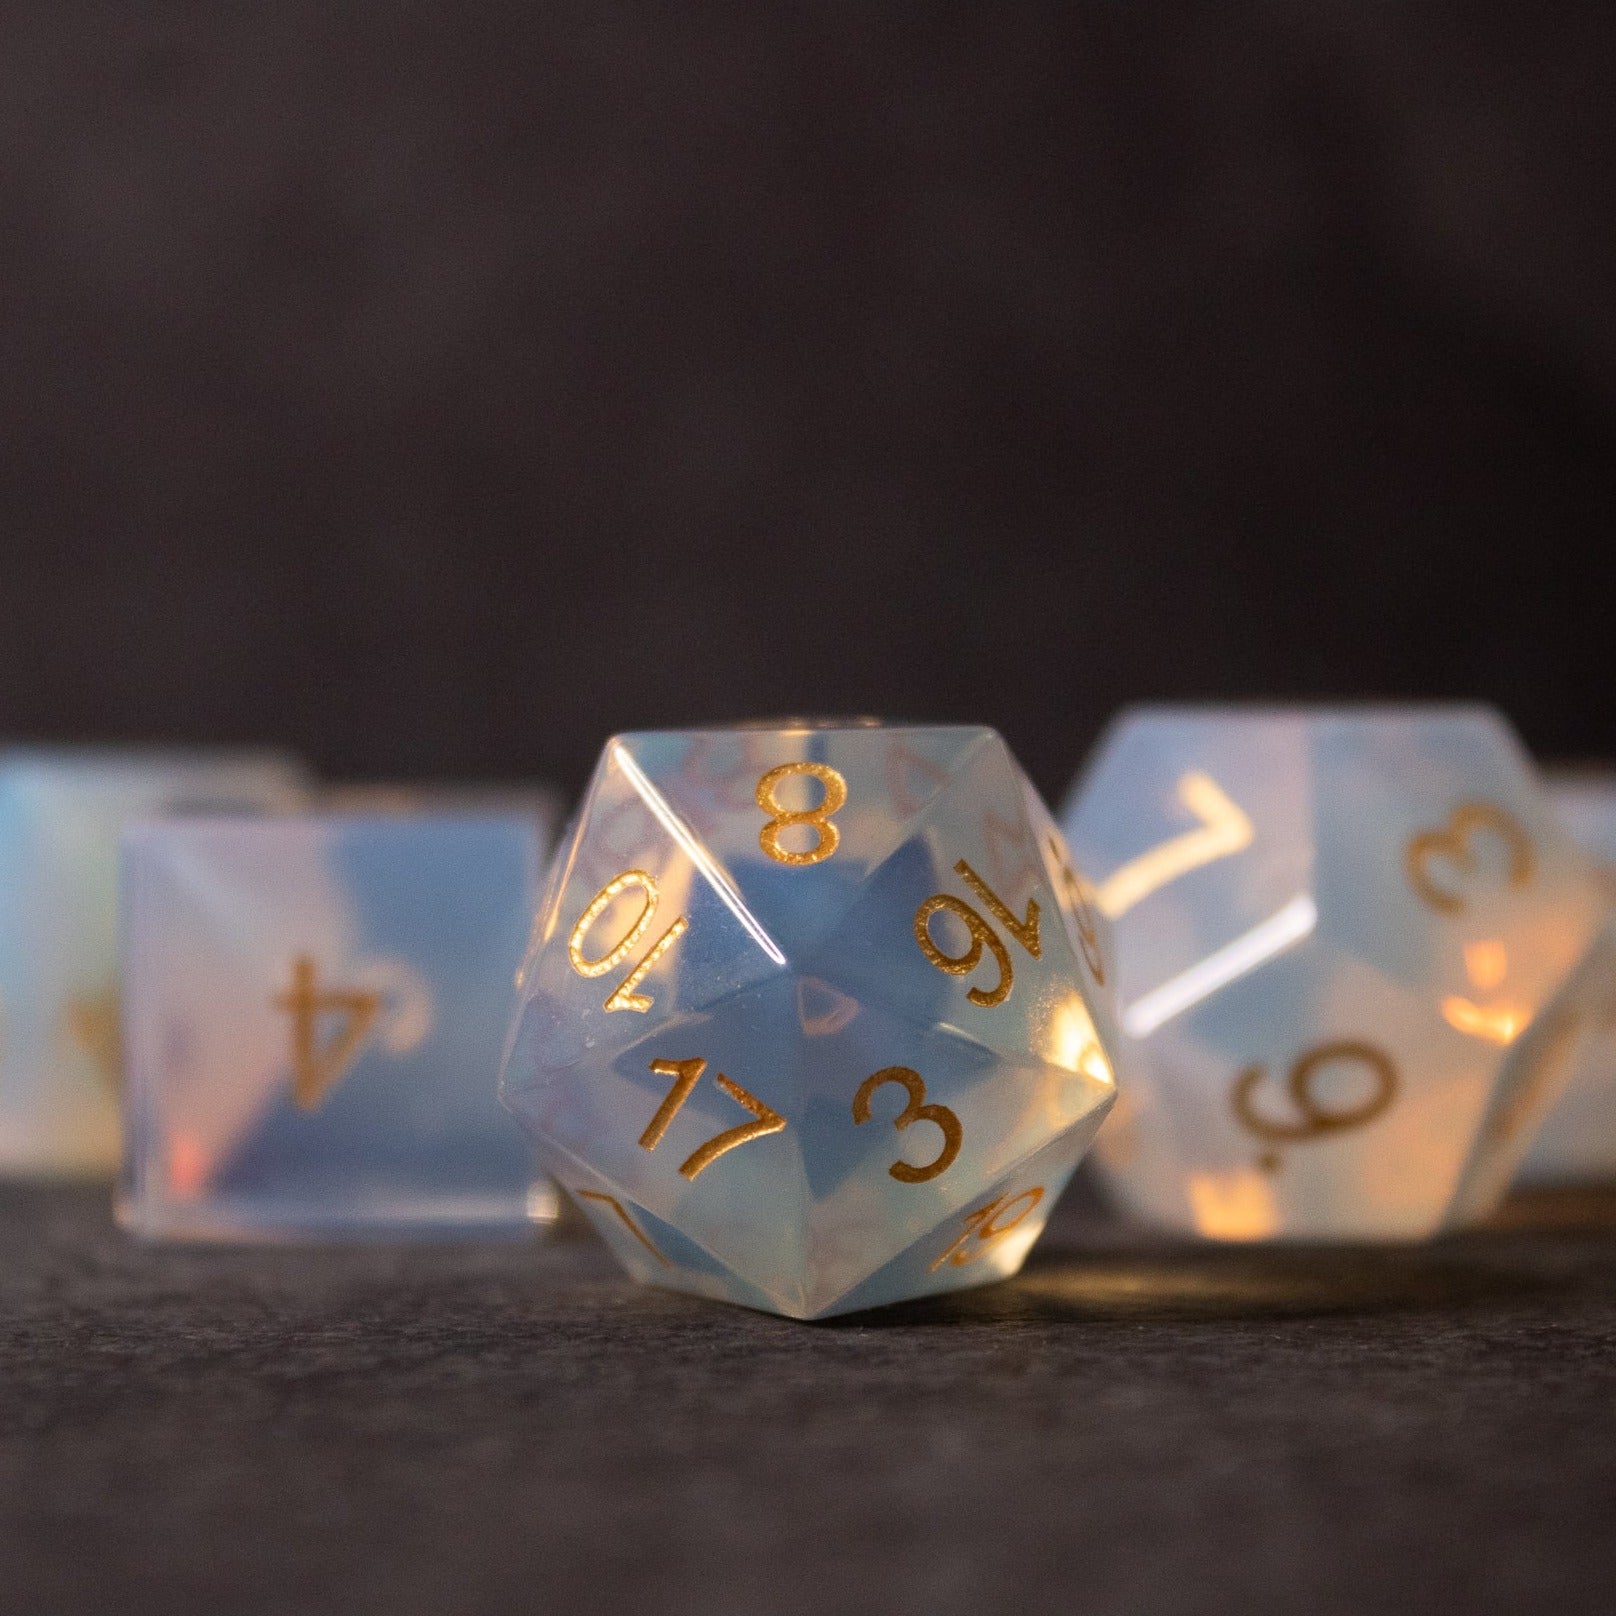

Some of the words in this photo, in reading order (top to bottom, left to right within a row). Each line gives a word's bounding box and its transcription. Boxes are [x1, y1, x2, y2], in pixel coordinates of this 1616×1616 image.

[755, 761, 847, 866] 8
[1406, 803, 1536, 919] 3
[568, 869, 689, 1013] 10
[914, 859, 1042, 1008] 16
[272, 956, 383, 1114] 4
[638, 1057, 787, 1180] 17
[853, 1066, 963, 1184] 3
